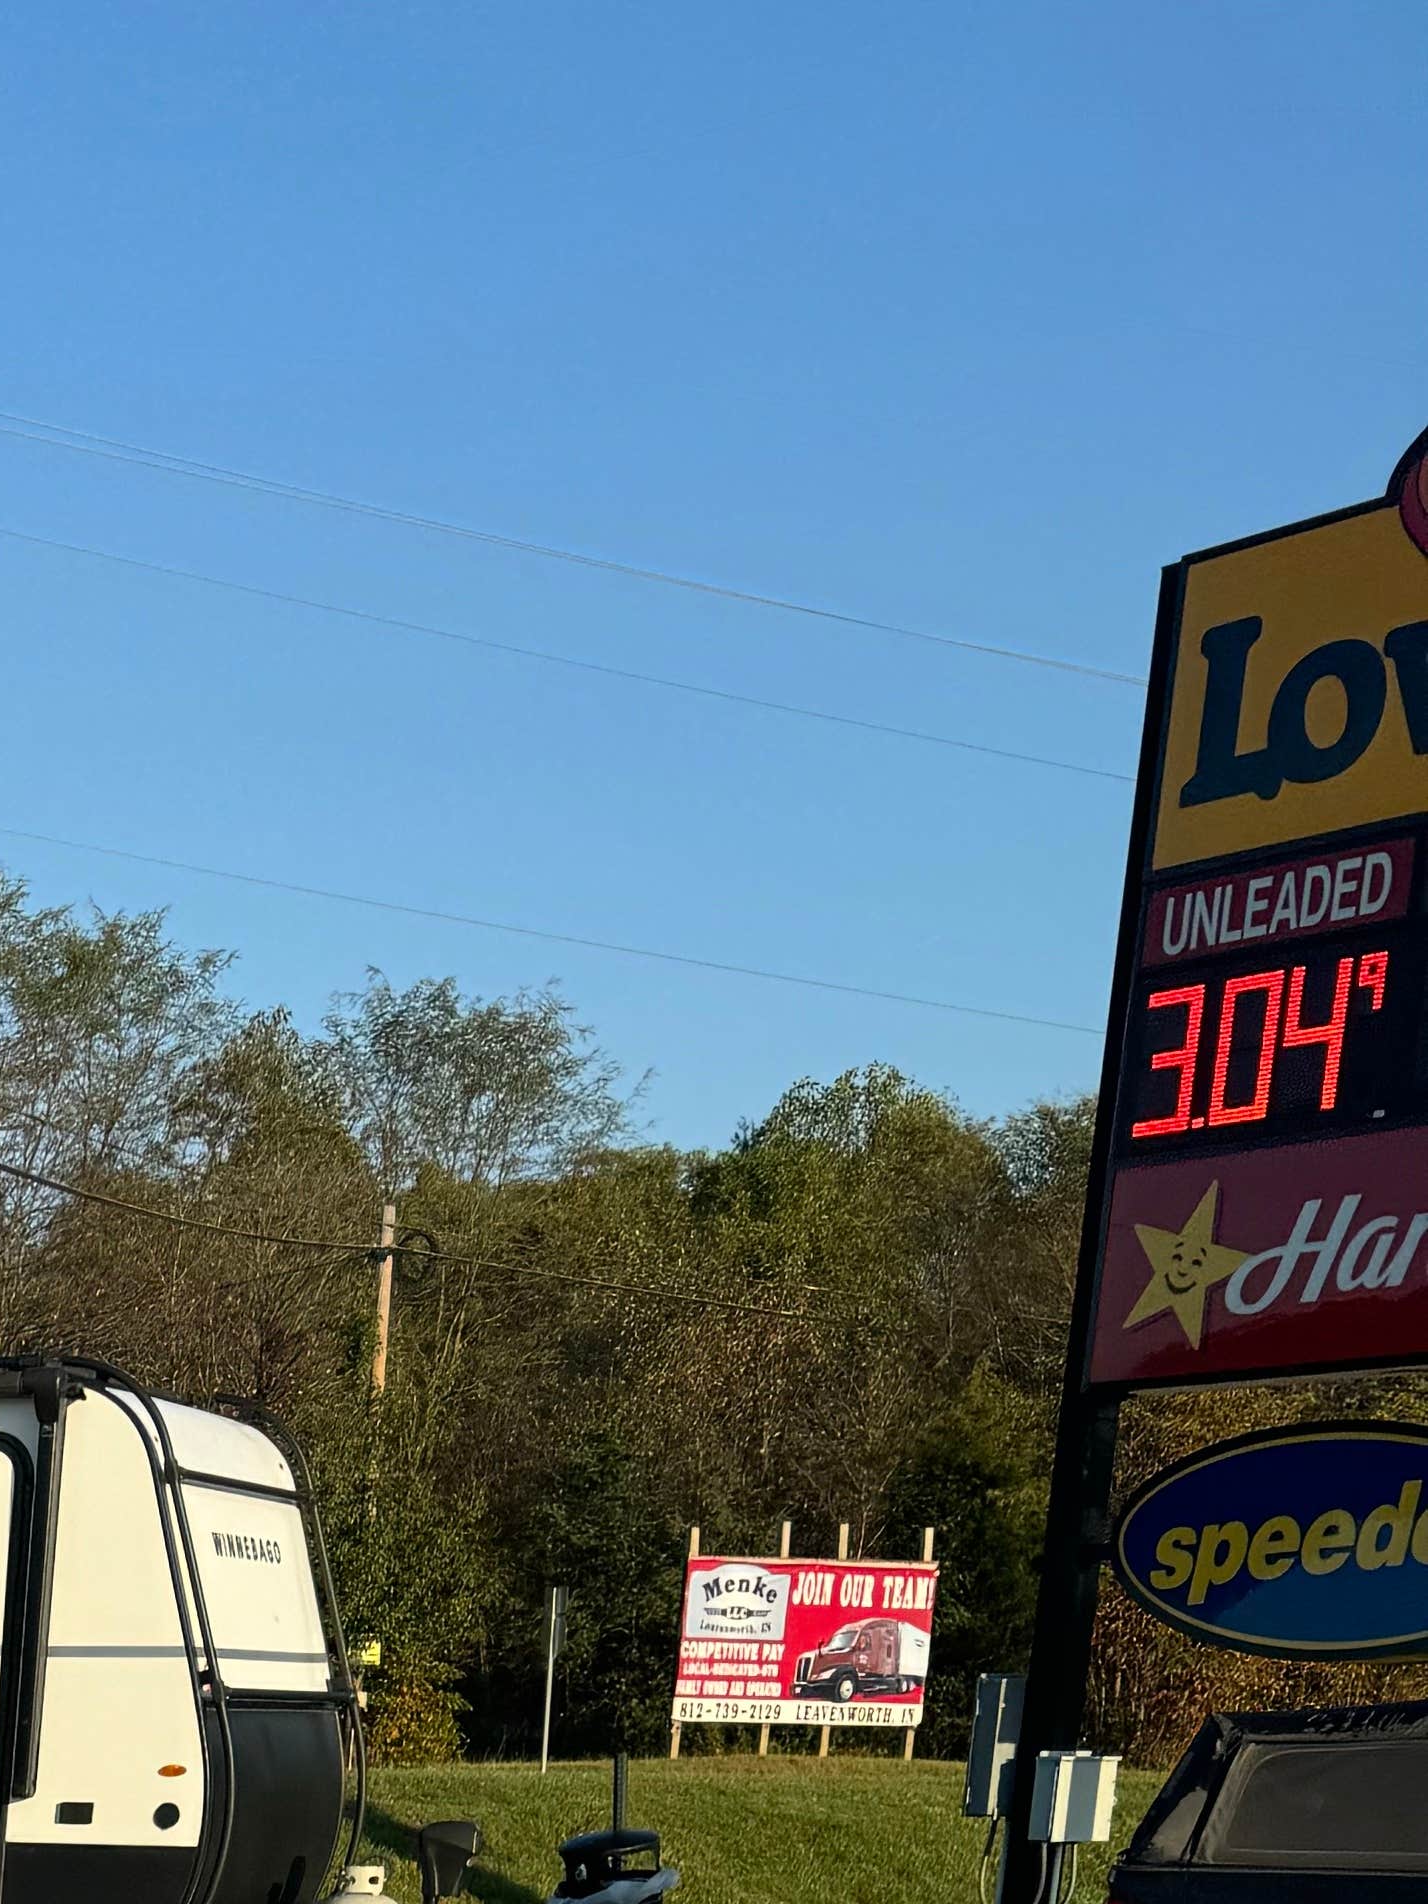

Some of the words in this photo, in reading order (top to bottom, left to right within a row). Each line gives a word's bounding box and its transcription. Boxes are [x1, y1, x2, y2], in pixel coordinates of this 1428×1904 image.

[1161, 850, 1393, 956] UNLEADED
[211, 1531, 281, 1564] WINNEBAGO
[702, 1576, 778, 1604] Menke
[792, 1571, 836, 1606] JOIN
[839, 1573, 875, 1608] OUR
[882, 1575, 935, 1610] TEAM!
[727, 1606, 748, 1620] LLC
[680, 1640, 760, 1661] COMPETITIVE
[762, 1643, 786, 1662] PAY
[679, 1702, 782, 1720] 812-739-2129
[901, 1708, 915, 1723] IN
